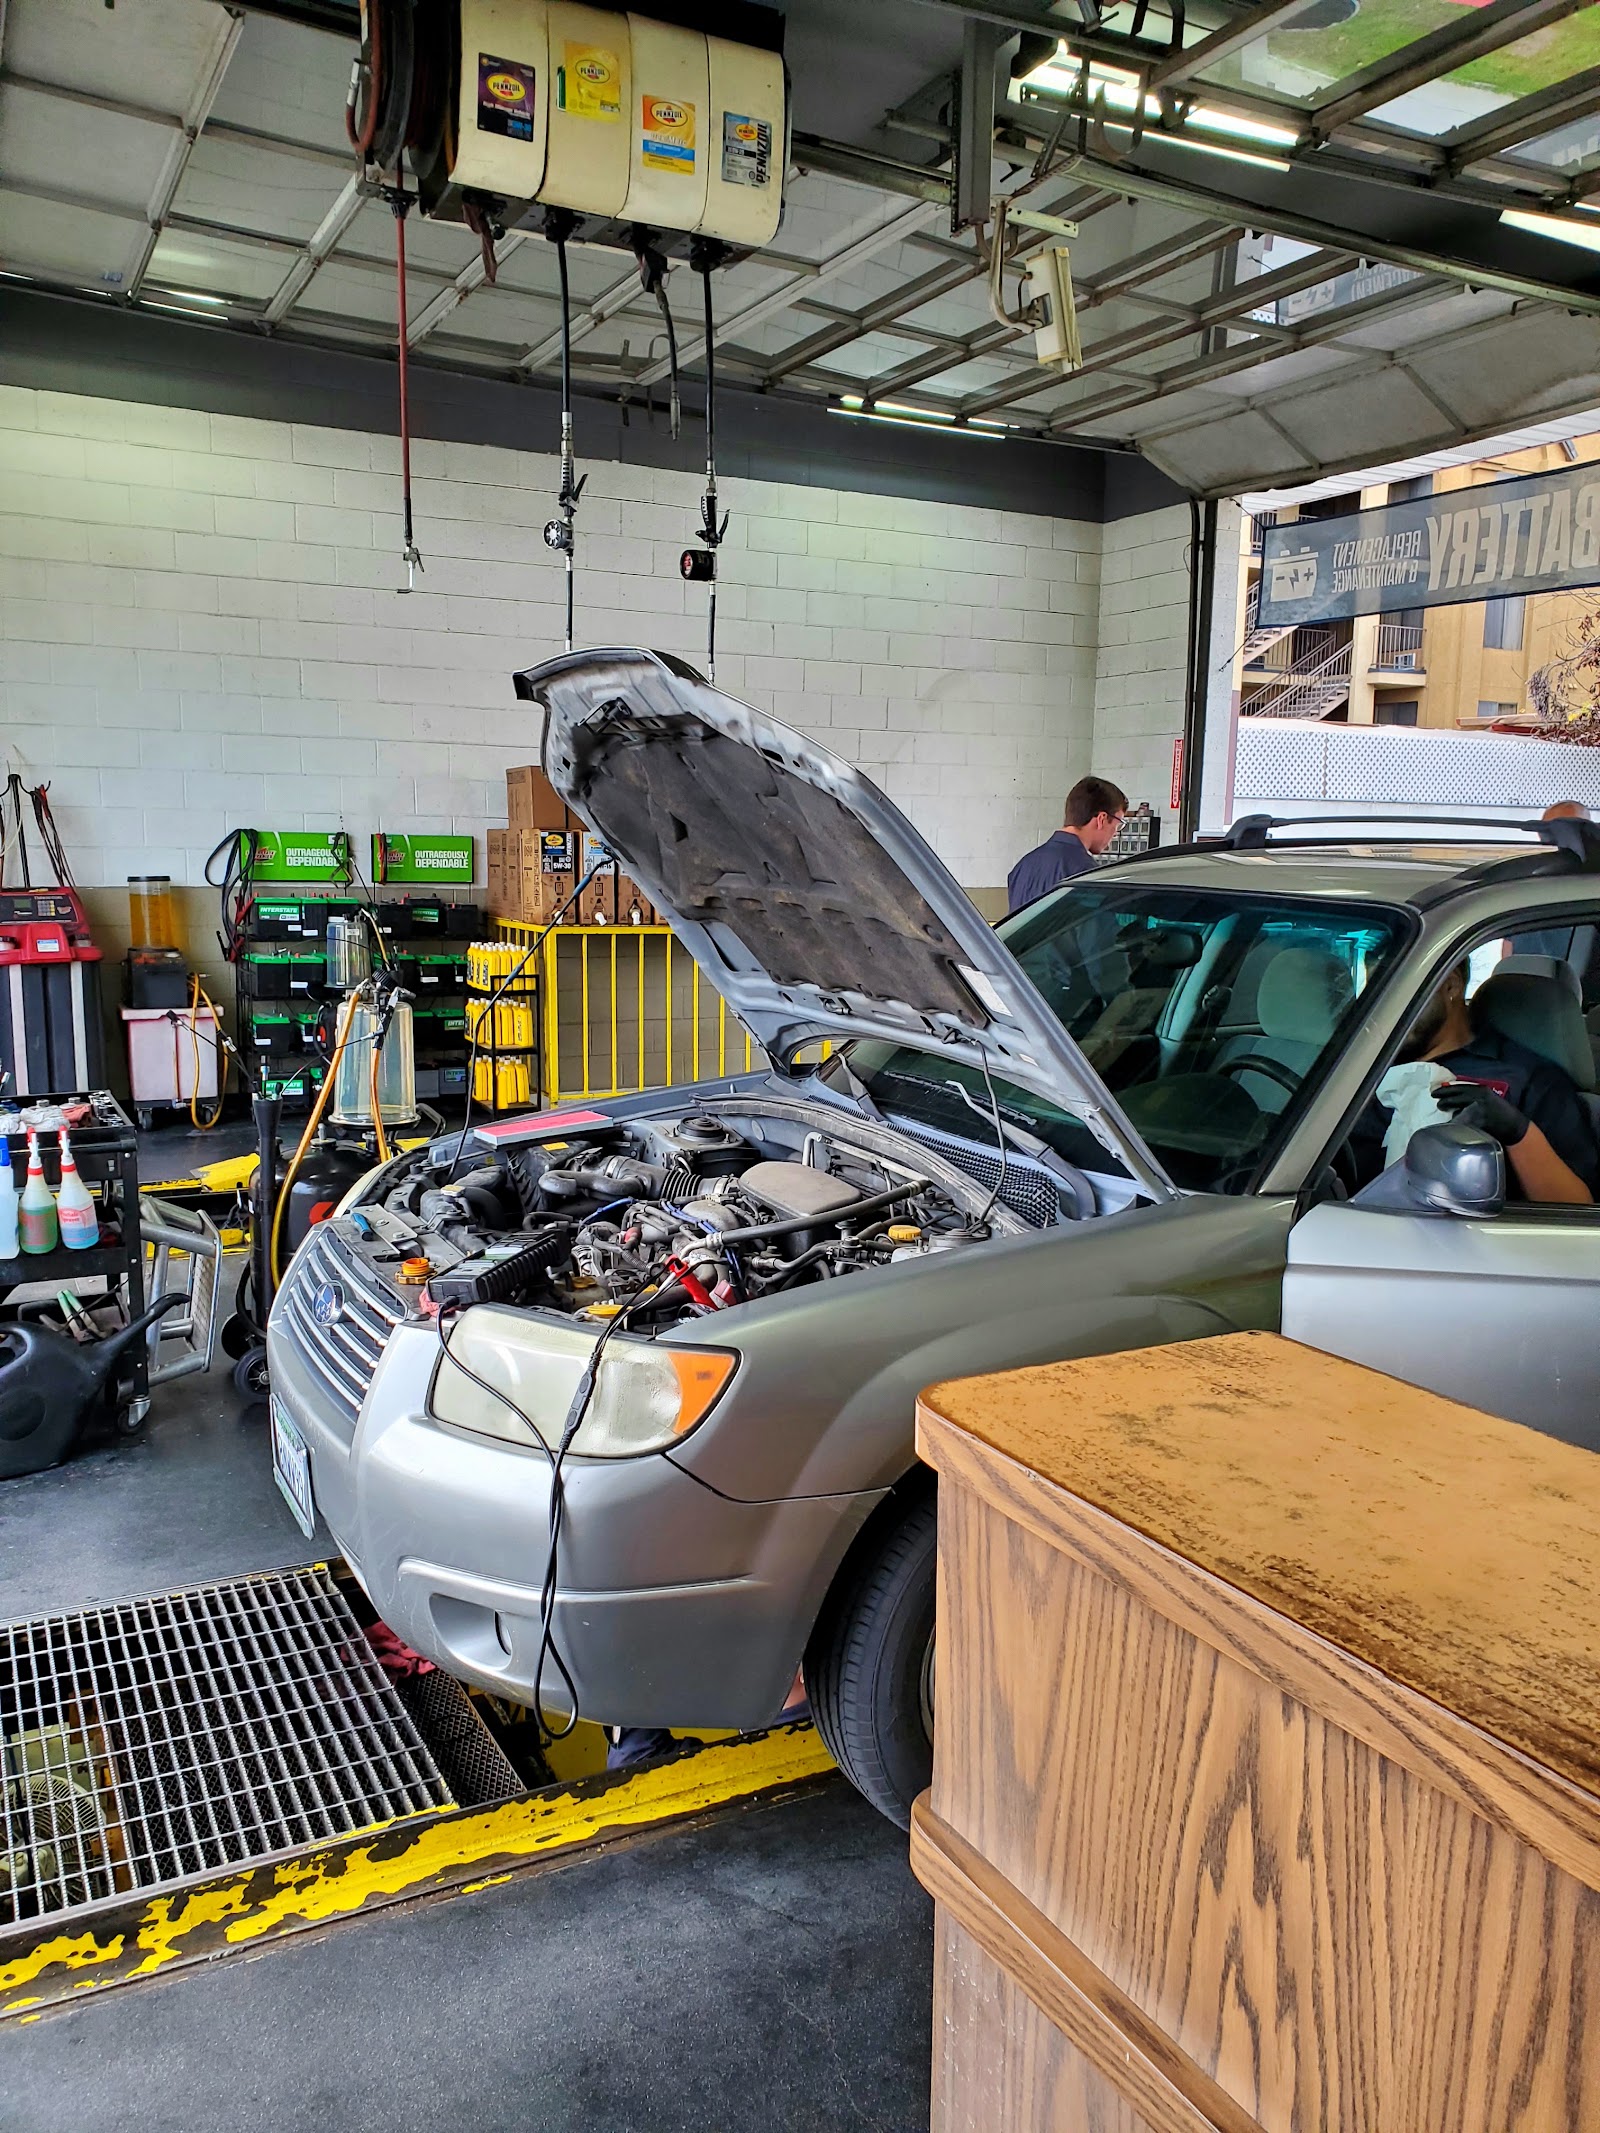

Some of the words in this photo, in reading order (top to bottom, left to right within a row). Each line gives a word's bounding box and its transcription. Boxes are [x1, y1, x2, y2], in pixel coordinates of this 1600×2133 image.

[581, 67, 605, 76] PENNZOIL
[492, 81, 520, 92] PENNZOIL
[656, 110, 682, 119] PENNZOIL
[756, 123, 768, 183] PENNZOIL
[286, 848, 343, 857] OUTRAGEOULY
[415, 850, 468, 859] OUTRAGEOUSLY
[415, 859, 468, 868] DEPENDABLE
